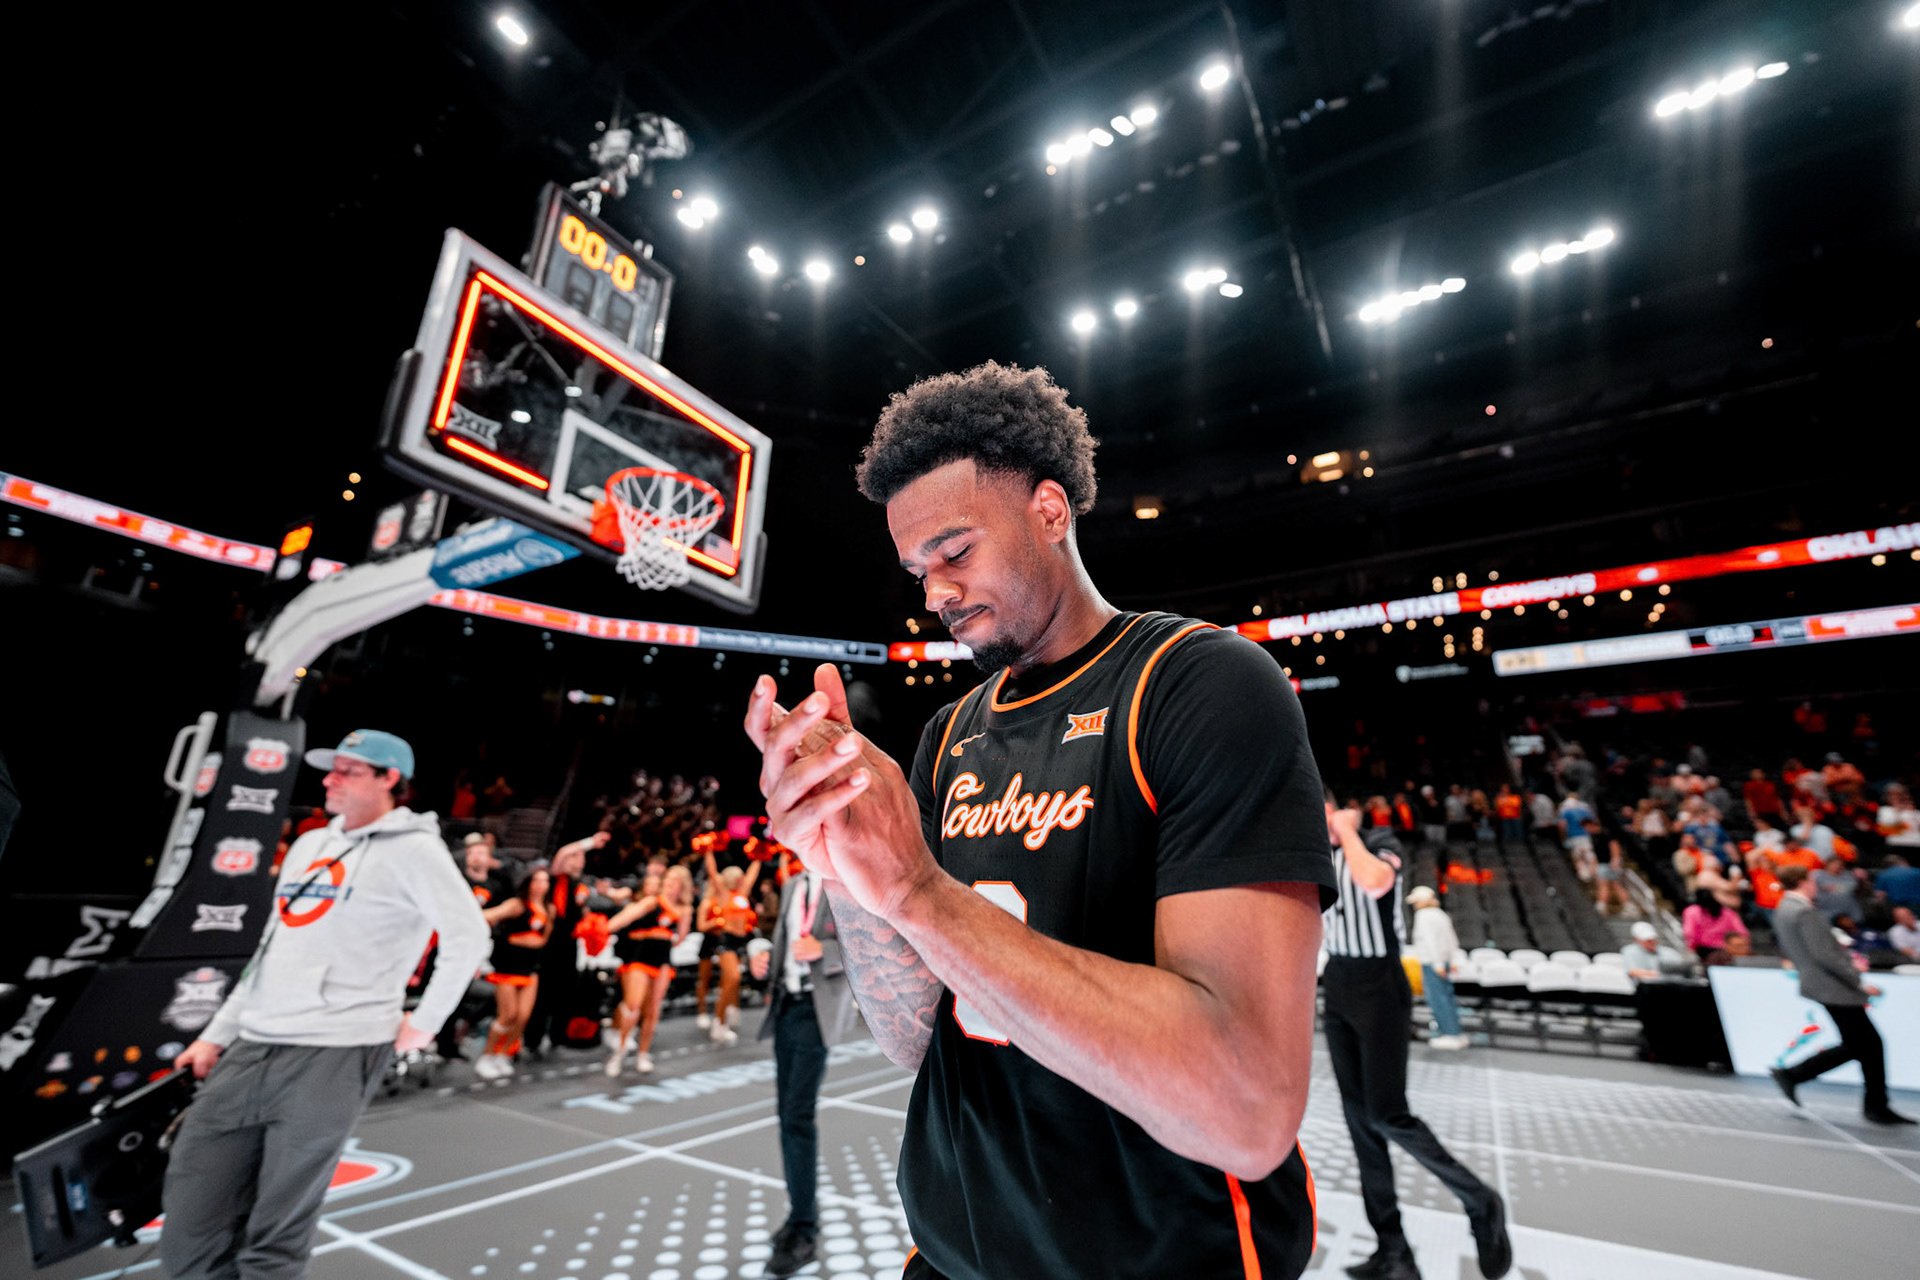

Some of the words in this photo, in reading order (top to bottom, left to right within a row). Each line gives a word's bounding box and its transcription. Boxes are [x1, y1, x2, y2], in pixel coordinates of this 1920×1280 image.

[559, 215, 638, 292] 00.0
[1268, 602, 1387, 640] OKLAHOMA
[1386, 591, 1461, 623] STATE
[1481, 572, 1596, 608] COWBOYS
[1066, 709, 1108, 738] XII
[941, 772, 1094, 851] Cowboys
